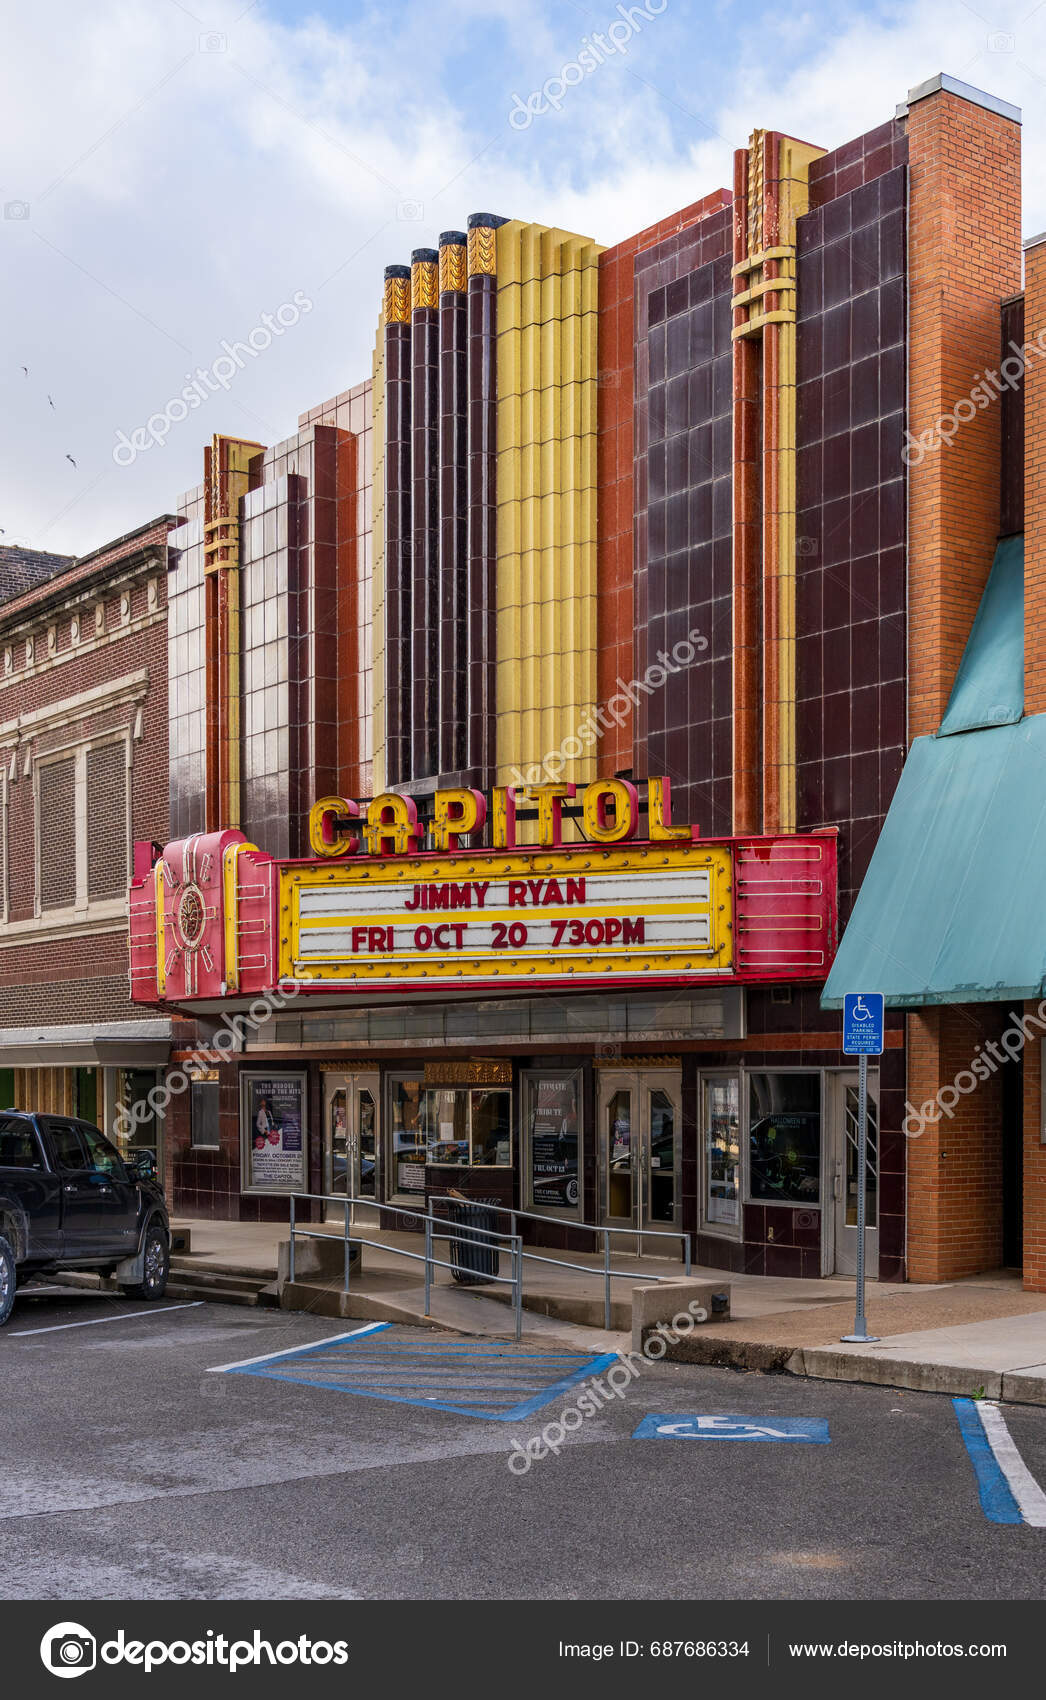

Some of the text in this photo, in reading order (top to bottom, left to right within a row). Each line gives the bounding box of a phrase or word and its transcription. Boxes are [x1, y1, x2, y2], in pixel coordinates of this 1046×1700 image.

[309, 776, 699, 858] CAPITOL
[404, 877, 586, 911] JIMMY RYAN
[351, 917, 645, 953] FRI OCT 20 730PM
